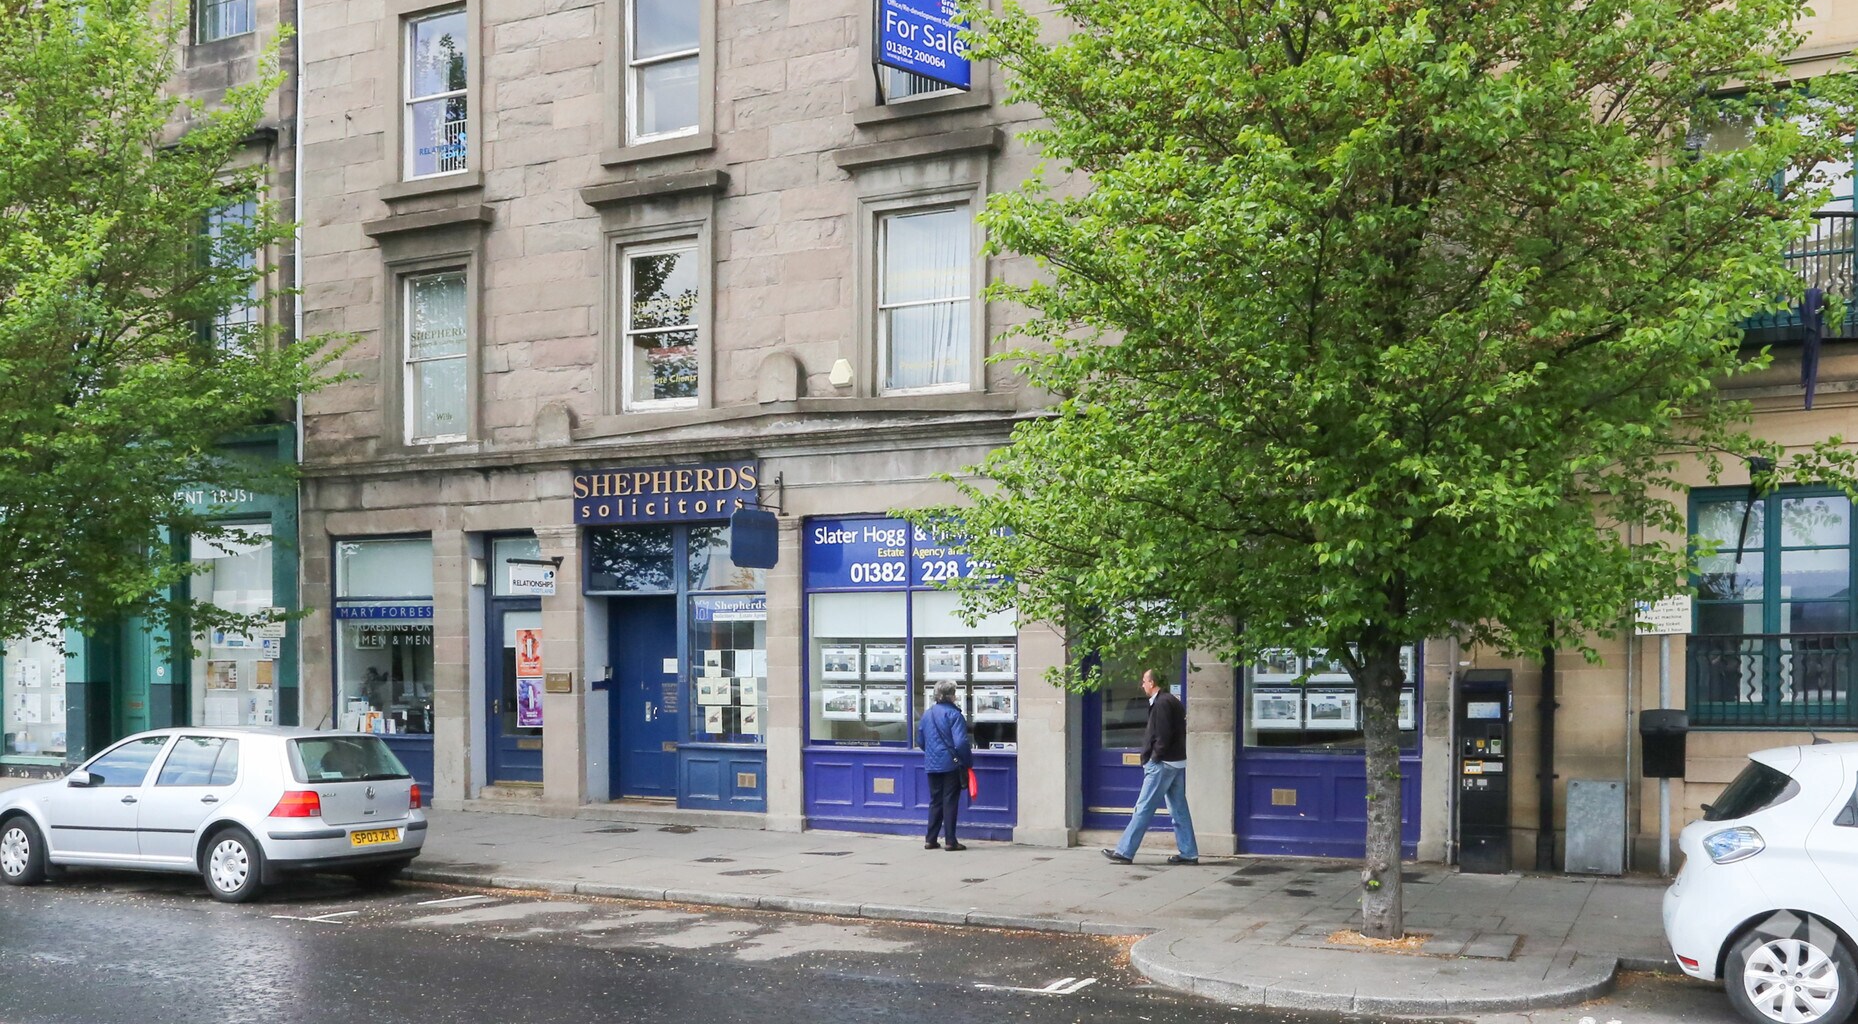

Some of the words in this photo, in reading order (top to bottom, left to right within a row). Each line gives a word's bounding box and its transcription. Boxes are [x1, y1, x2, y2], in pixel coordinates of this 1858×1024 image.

[886, 10, 918, 40] For
[923, 24, 965, 57] Sale
[886, 40, 913, 58] 01382
[914, 50, 946, 68] 200064
[574, 465, 757, 499] SHEPHERDS
[582, 496, 744, 518] solicitors
[814, 526, 858, 545] Slater
[863, 526, 906, 547] Hogg
[914, 525, 927, 541] &
[878, 548, 905, 558] Estate
[912, 547, 945, 559] Agency
[850, 562, 905, 583] 01382
[921, 560, 959, 582] 228
[512, 579, 554, 588] RELATIONSHIPS
[341, 607, 374, 618] MARY
[381, 607, 431, 617] FORBES
[714, 600, 767, 612] Shepherds
[411, 622, 431, 631] FOR
[392, 636, 399, 645] &
[405, 635, 431, 646] MEN
[354, 831, 378, 844] SP03
[379, 829, 396, 842] ZRJ
